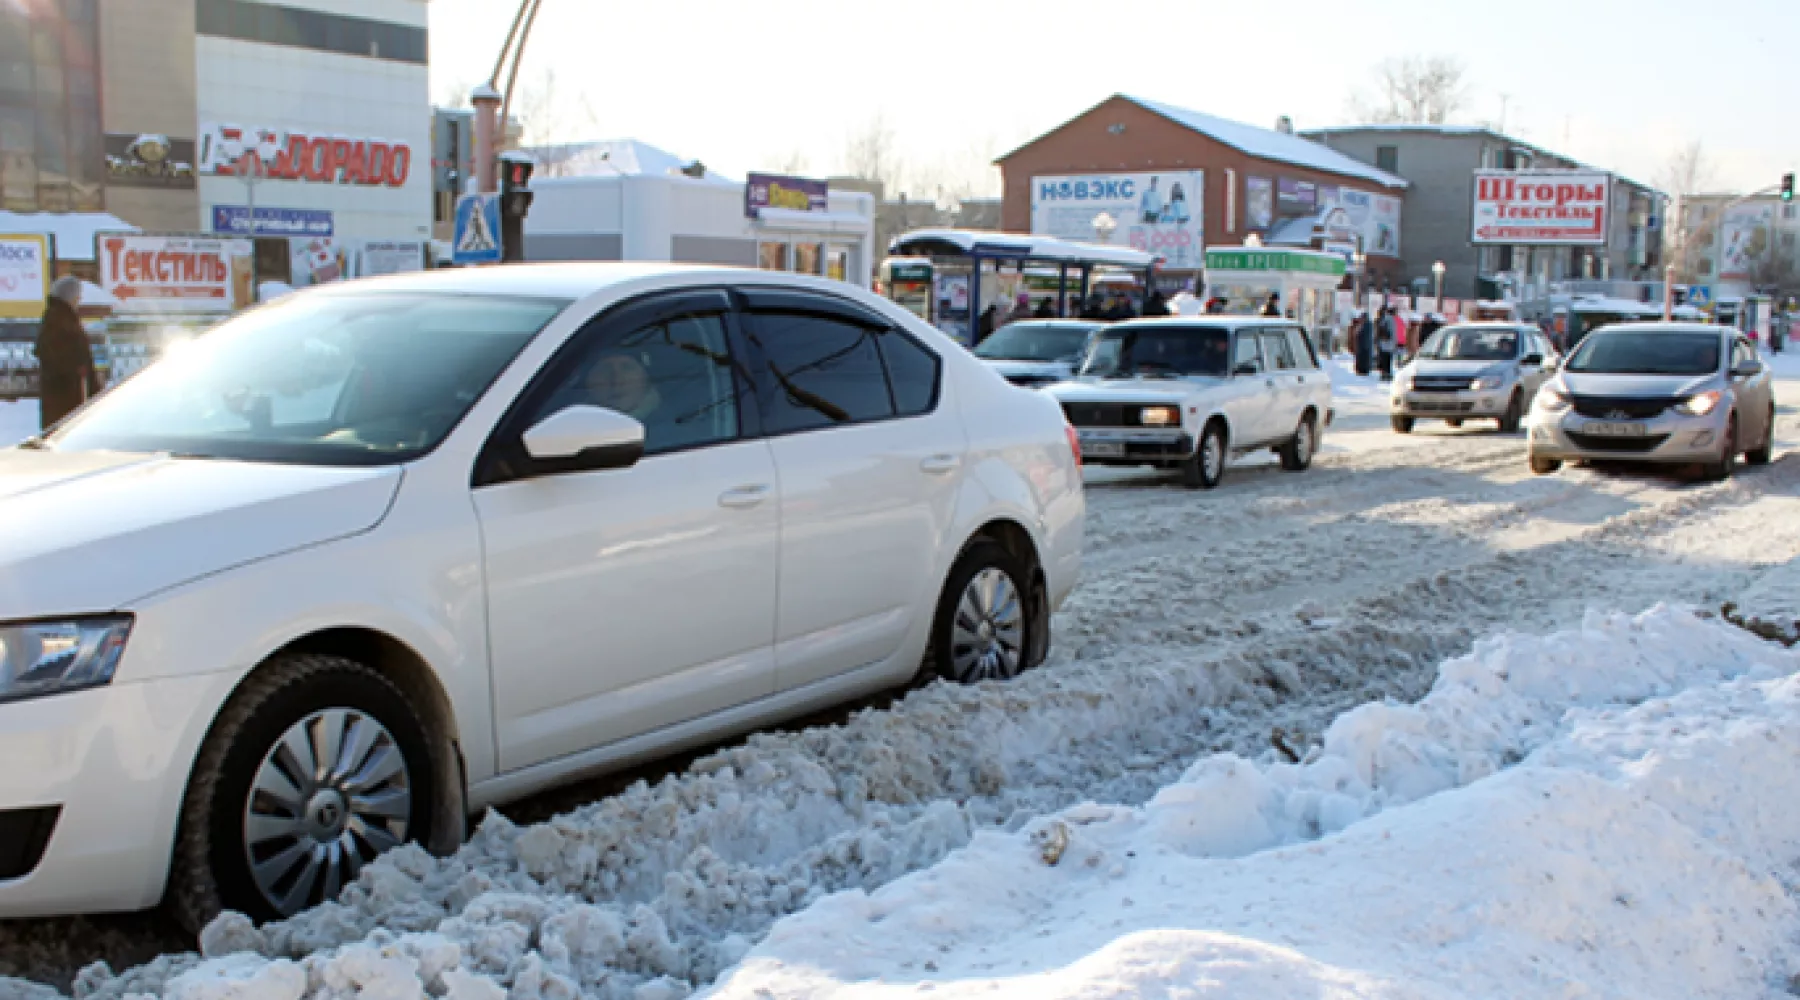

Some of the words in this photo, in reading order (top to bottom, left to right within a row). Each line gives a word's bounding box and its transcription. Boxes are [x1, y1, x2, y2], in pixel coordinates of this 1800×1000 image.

[1478, 178, 1604, 205] Шторы
[1497, 205, 1594, 219] Текстиль
[105, 238, 227, 282] Текстиль
